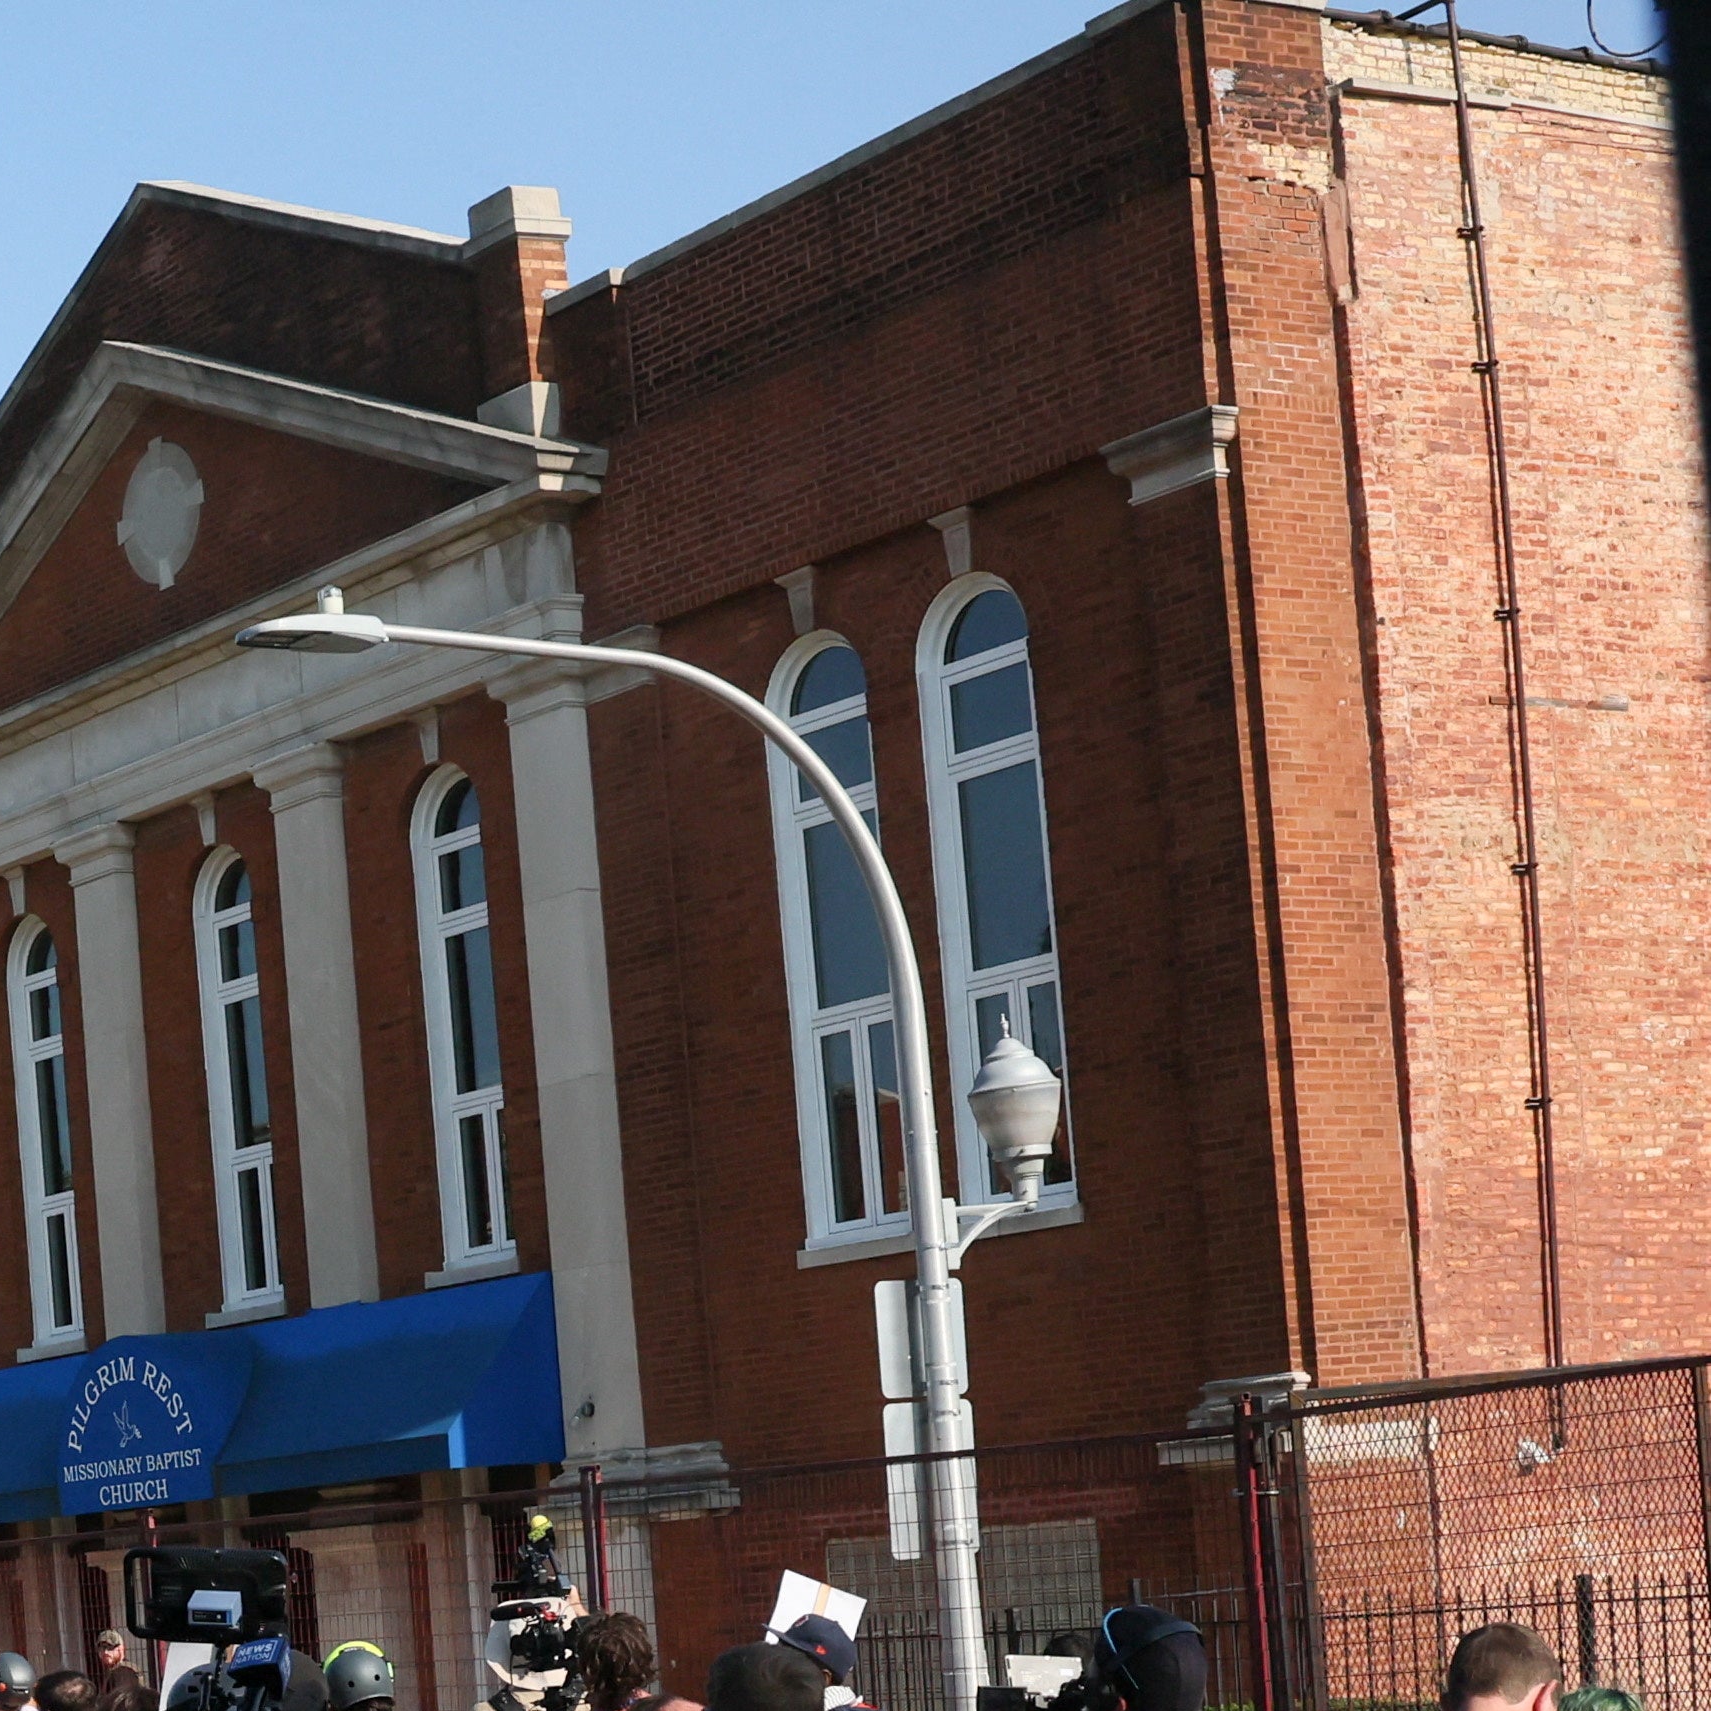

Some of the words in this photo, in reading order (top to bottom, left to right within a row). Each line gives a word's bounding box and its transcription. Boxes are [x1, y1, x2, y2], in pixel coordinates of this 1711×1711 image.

[68, 1357, 135, 1453] PILGRIM
[142, 1360, 193, 1435] REST
[63, 1456, 142, 1483] MISSIONARY
[146, 1448, 202, 1472] BAPTIST
[99, 1478, 168, 1506] CHURCH
[238, 1643, 273, 1656] NEWS
